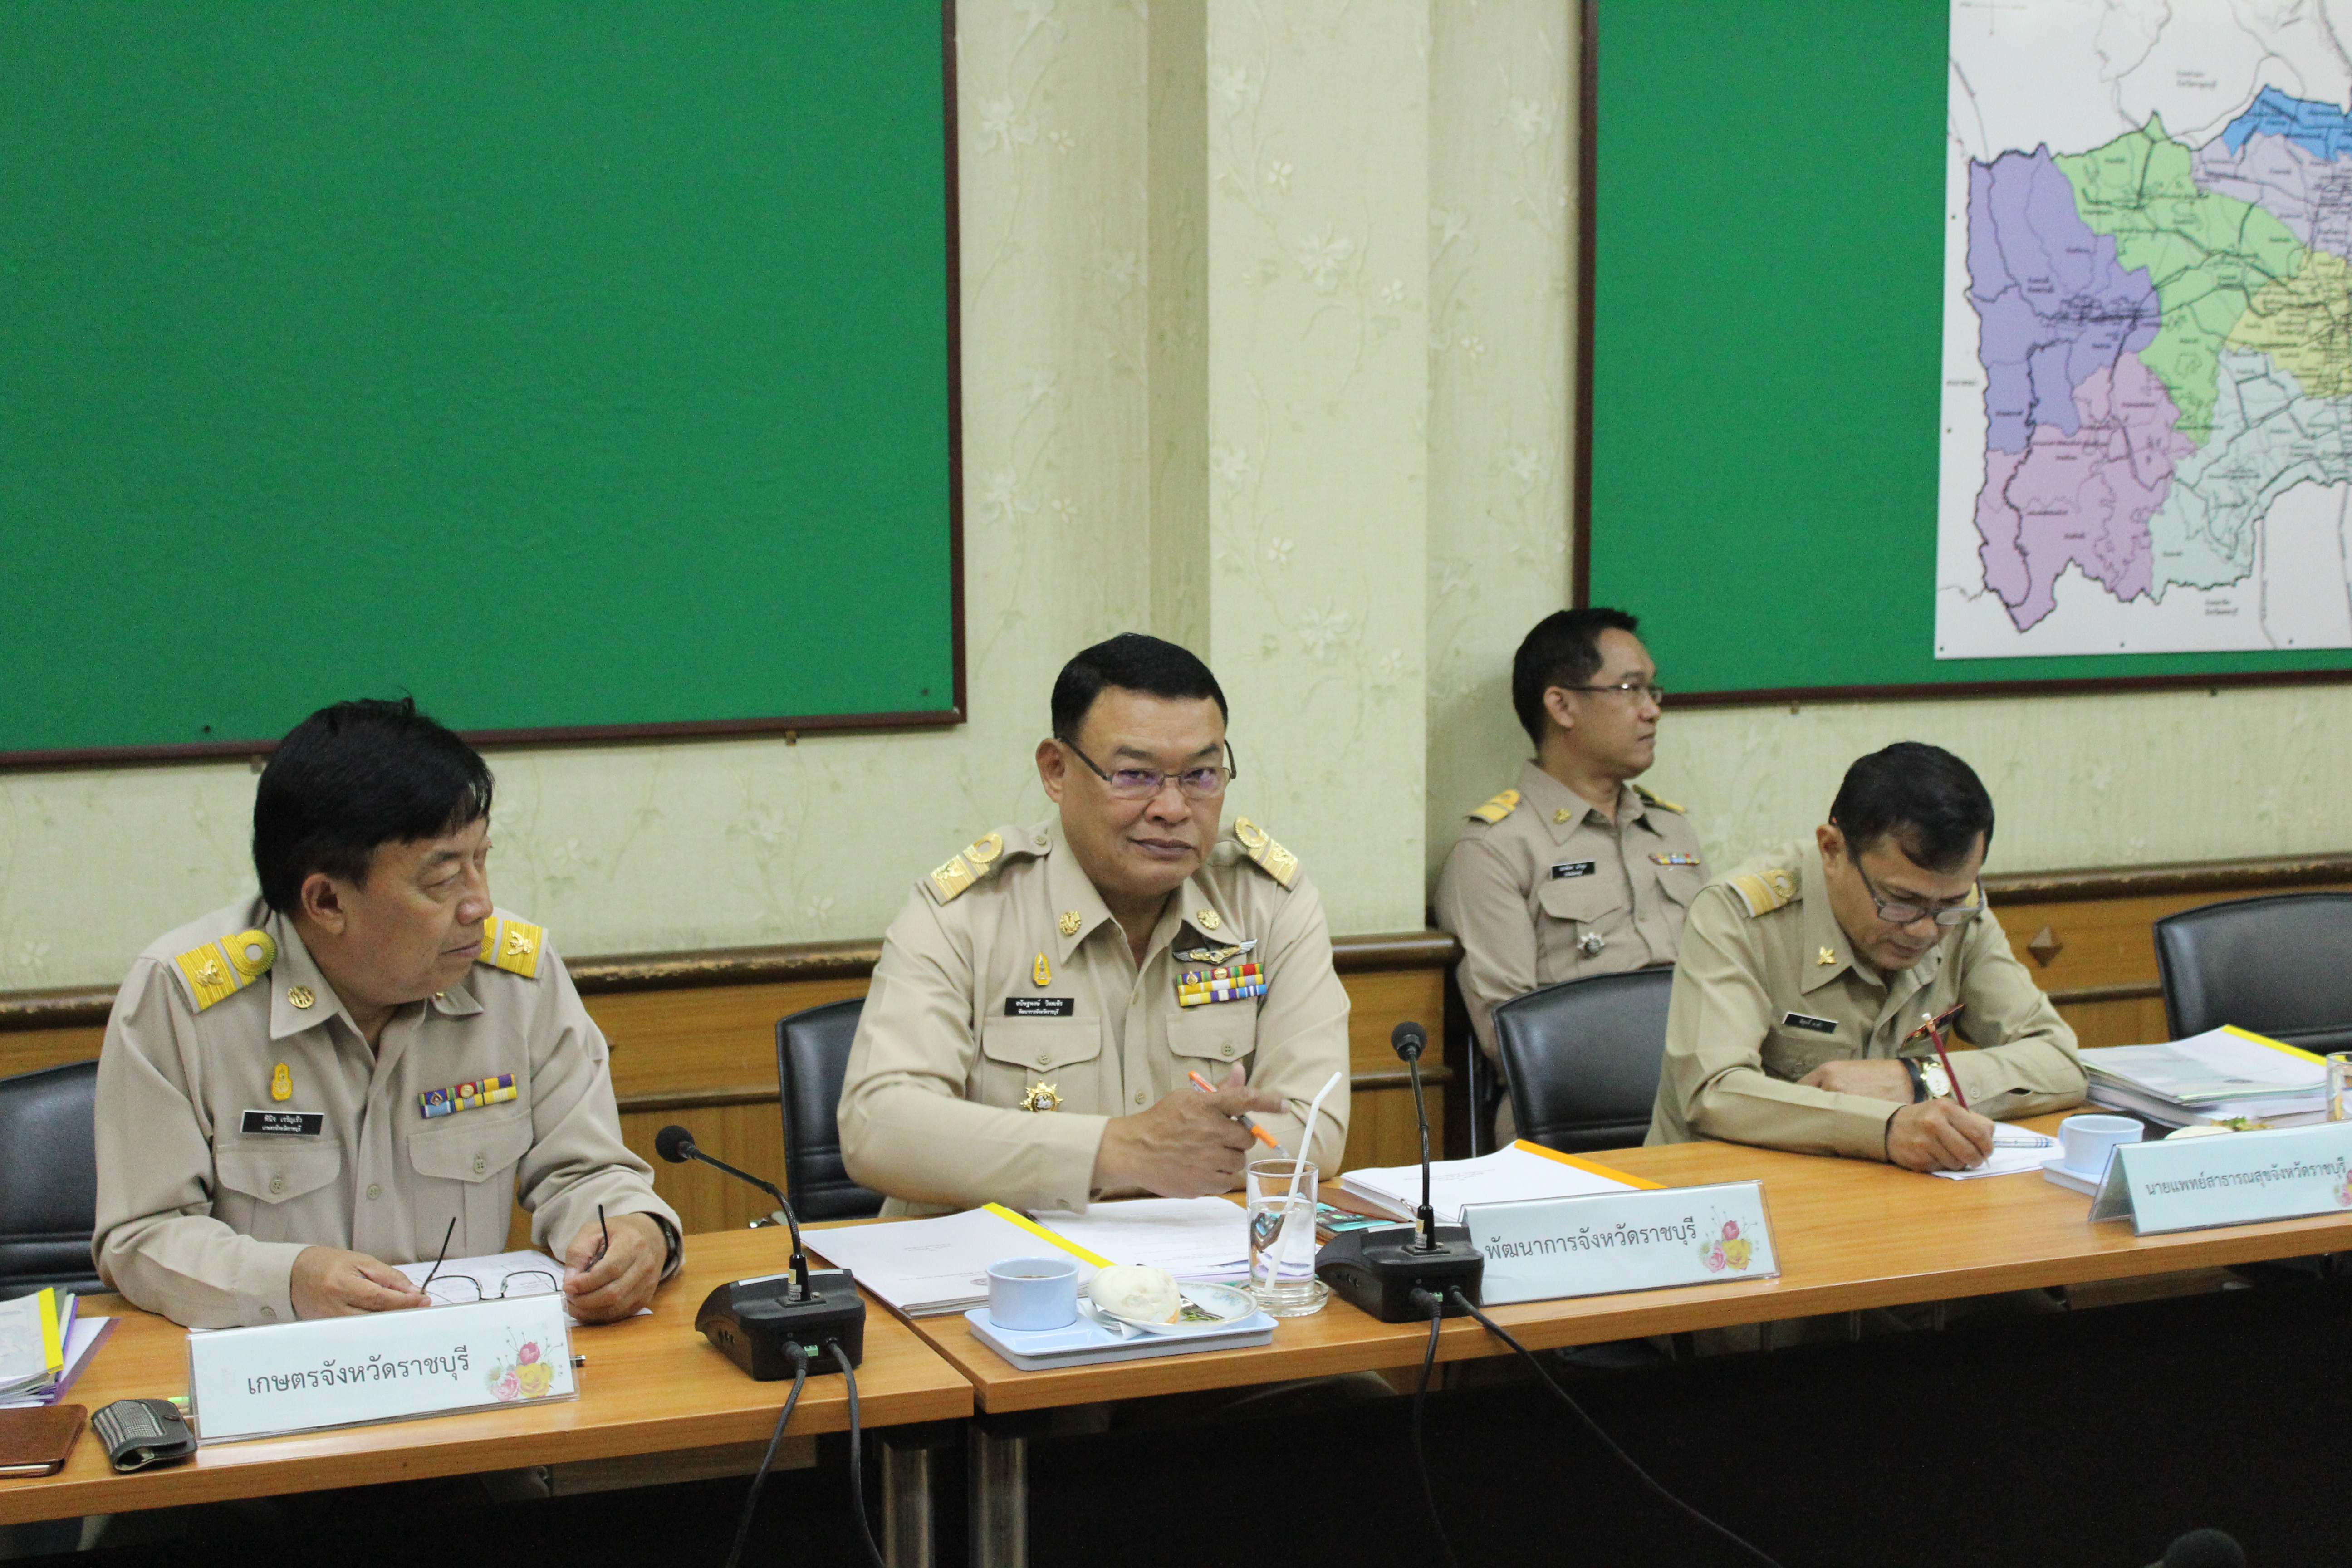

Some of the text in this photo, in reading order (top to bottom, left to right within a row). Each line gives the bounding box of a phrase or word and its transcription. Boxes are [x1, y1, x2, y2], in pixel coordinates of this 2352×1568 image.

[2146, 1156, 2346, 1195] นายแพทย์สาธารณสุขจังหวัดราชบุรี
[1485, 1216, 1697, 1260] พัฒนาการจังหวัดราชบุรี
[248, 1345, 470, 1396] เกษตรจังหวัดราชบุรี
